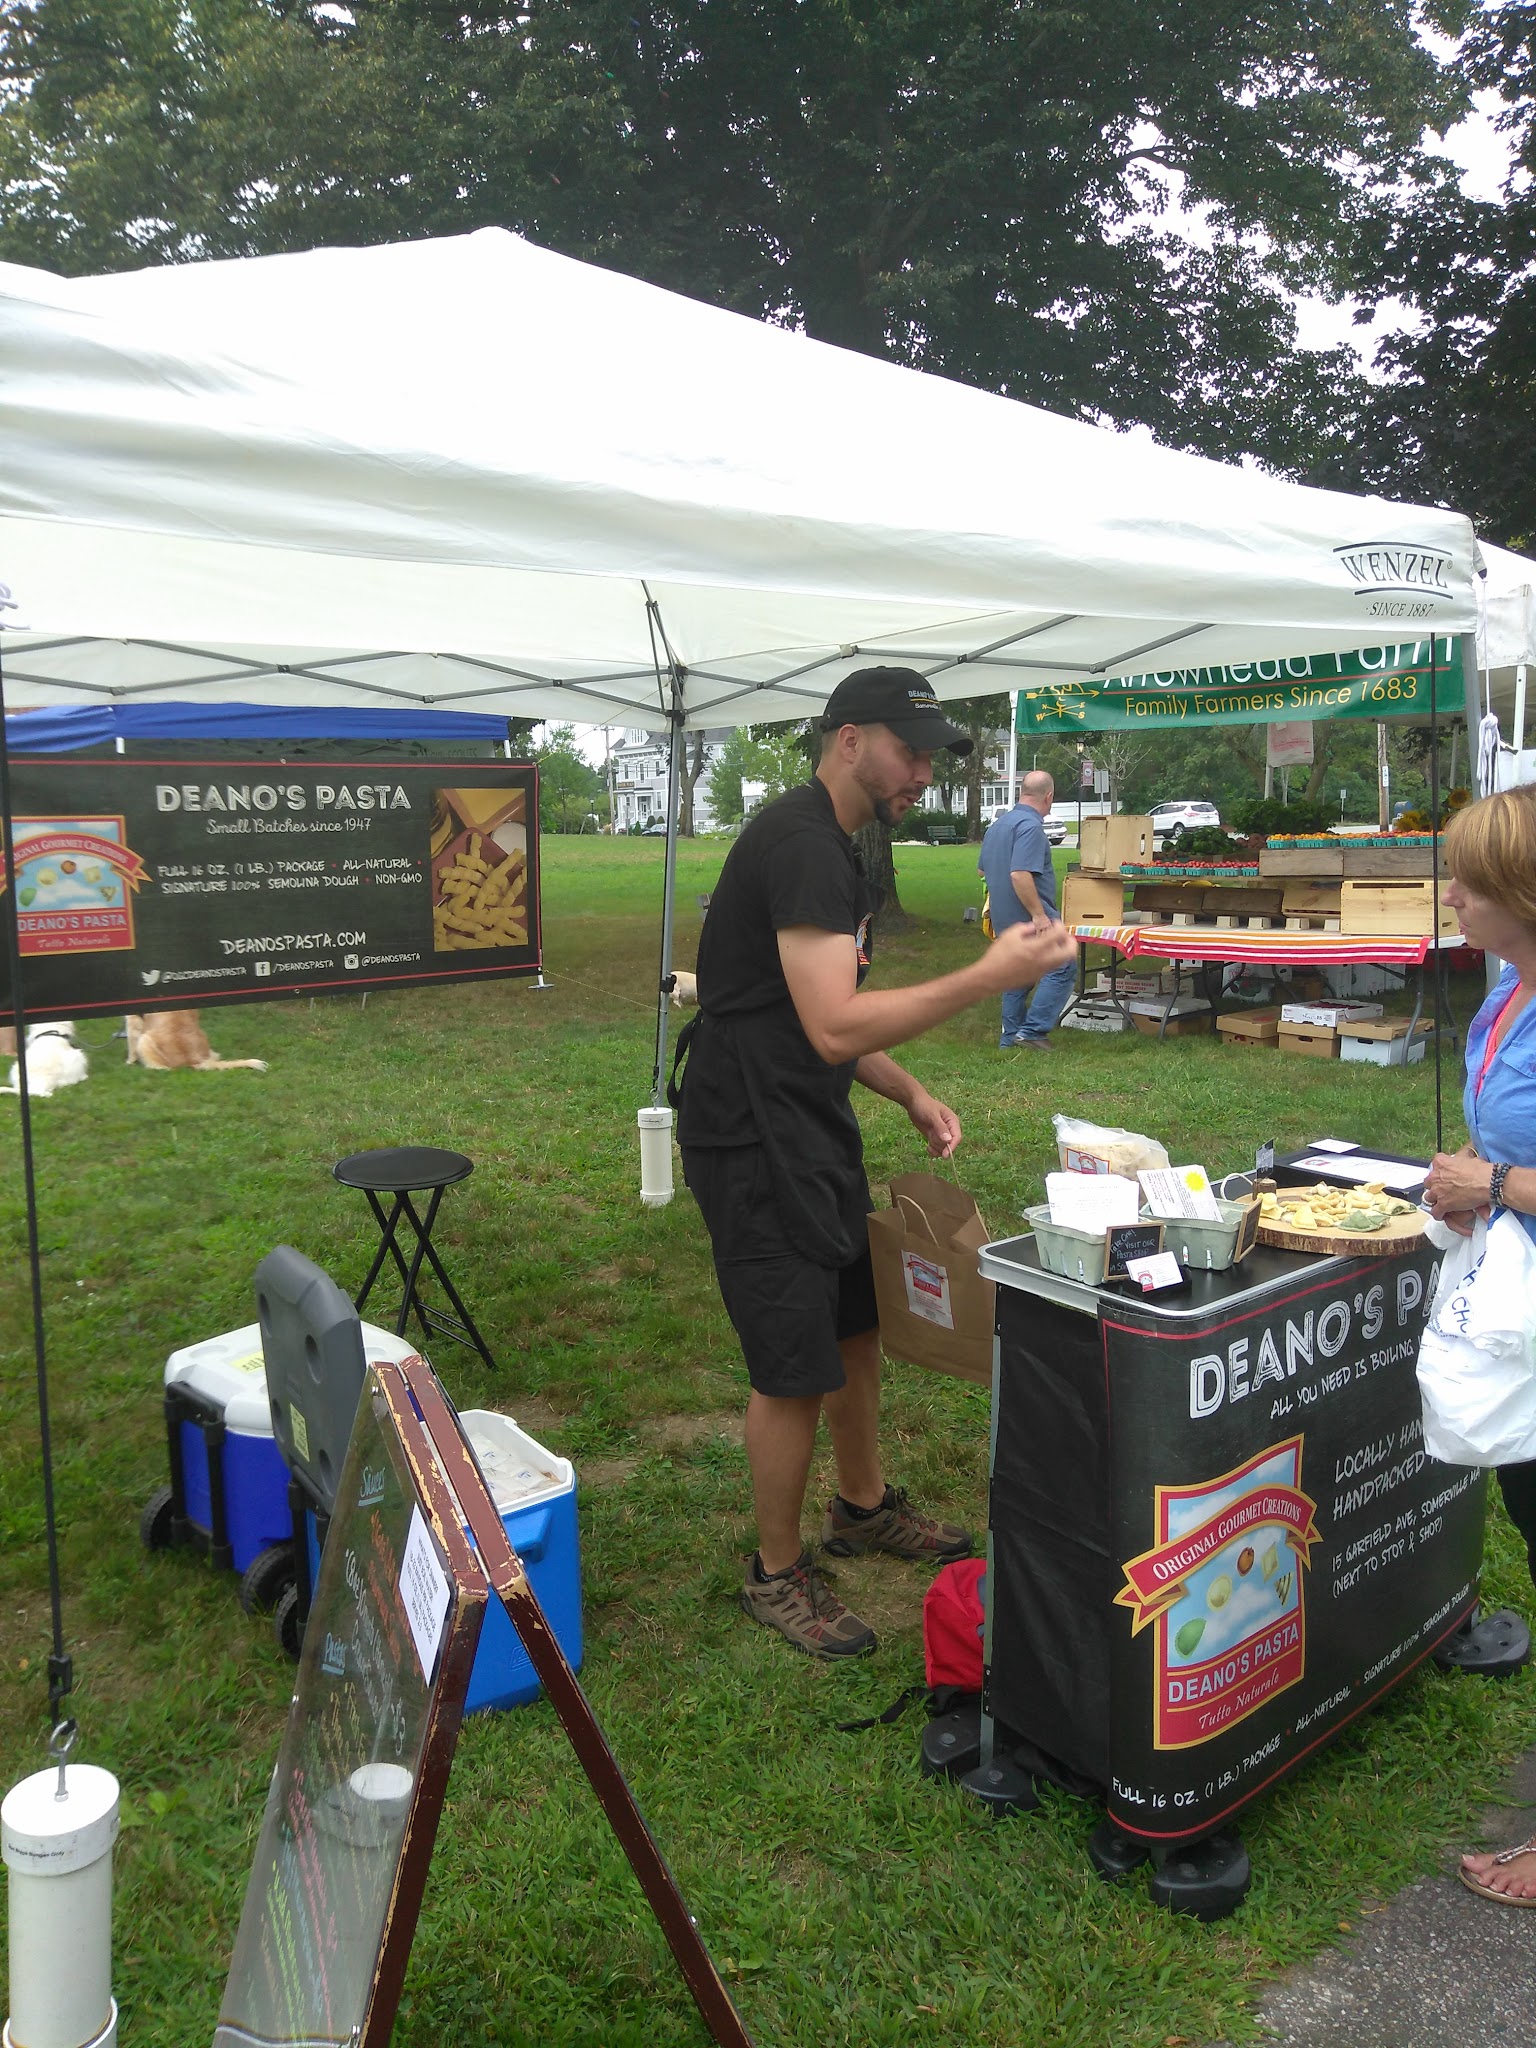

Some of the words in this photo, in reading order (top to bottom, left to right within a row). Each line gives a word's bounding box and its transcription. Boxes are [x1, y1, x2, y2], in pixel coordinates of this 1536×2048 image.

[1369, 602, 1406, 617] SINCE
[1407, 603, 1434, 617] 1887
[1125, 694, 1188, 719] Family
[1194, 692, 1283, 713] Farmers
[1290, 685, 1352, 709] Since
[1360, 676, 1418, 701] 1683
[155, 785, 307, 812] DEANO'S
[315, 785, 412, 810] PASTA
[205, 818, 252, 835] Small
[252, 817, 309, 834] Batches
[310, 819, 343, 833] since
[344, 817, 372, 832] 1947
[157, 865, 189, 877] FULL
[191, 865, 203, 876] 16
[276, 861, 326, 873] PACKAGE
[342, 857, 412, 870] ALL-NATURAL
[161, 880, 228, 894] SIGNATURE
[231, 879, 261, 892] 100%
[267, 877, 320, 890] SEMOLINA
[323, 875, 359, 888] DOUGH
[375, 873, 423, 885] NON-GMO
[83, 914, 127, 928] PASTA
[220, 931, 367, 955] DEANOSPASTA.COM
[361, 952, 421, 967] @DEANOSPASTA
[1125, 1241, 1142, 1250] VISIT
[1189, 1284, 1385, 1419] DEANO'S
[1269, 1396, 1294, 1419] ALL
[1296, 1384, 1318, 1408] YOU
[1321, 1366, 1351, 1395] NEED
[1354, 1359, 1368, 1380] IS
[1369, 1340, 1414, 1371] BOILING
[1334, 1432, 1395, 1484] LOCALLY
[1333, 1450, 1426, 1521] HANDPACKED
[1152, 1532, 1218, 1580] ORIGINAL
[1217, 1501, 1262, 1540] GOURMET
[1262, 1496, 1301, 1522] CREATIONS
[1332, 1552, 1342, 1572] 15
[1345, 1522, 1392, 1562] GARFIELD
[1395, 1508, 1417, 1534] AVE,
[1421, 1474, 1469, 1518] SOMERVILLE
[1469, 1465, 1481, 1485] MA
[1332, 1565, 1361, 1598] (NEXT
[1364, 1556, 1378, 1575] TO
[1381, 1538, 1405, 1566] STOP
[1408, 1531, 1415, 1553] &
[1419, 1516, 1443, 1544] SHOP)
[1168, 1652, 1250, 1703] DEANO'S
[1253, 1622, 1299, 1666] PASTA
[1112, 1776, 1146, 1805] FULL
[1152, 1794, 1166, 1809] 16
[1174, 1790, 1199, 1807] OZ.
[1204, 1781, 1214, 1798] (1
[1218, 1764, 1240, 1790] LB.)
[1242, 1733, 1281, 1773] PACKAGE
[1295, 1685, 1351, 1733] ALL-NATURAL
[1363, 1643, 1402, 1684] SIGNATURE
[1403, 1631, 1420, 1652] 100%
[1422, 1604, 1451, 1635] SEMOLINA
[1451, 1583, 1470, 1608] DOUGH
[1198, 1703, 1232, 1731] Tutto
[1234, 1667, 1280, 1711] Naturale
